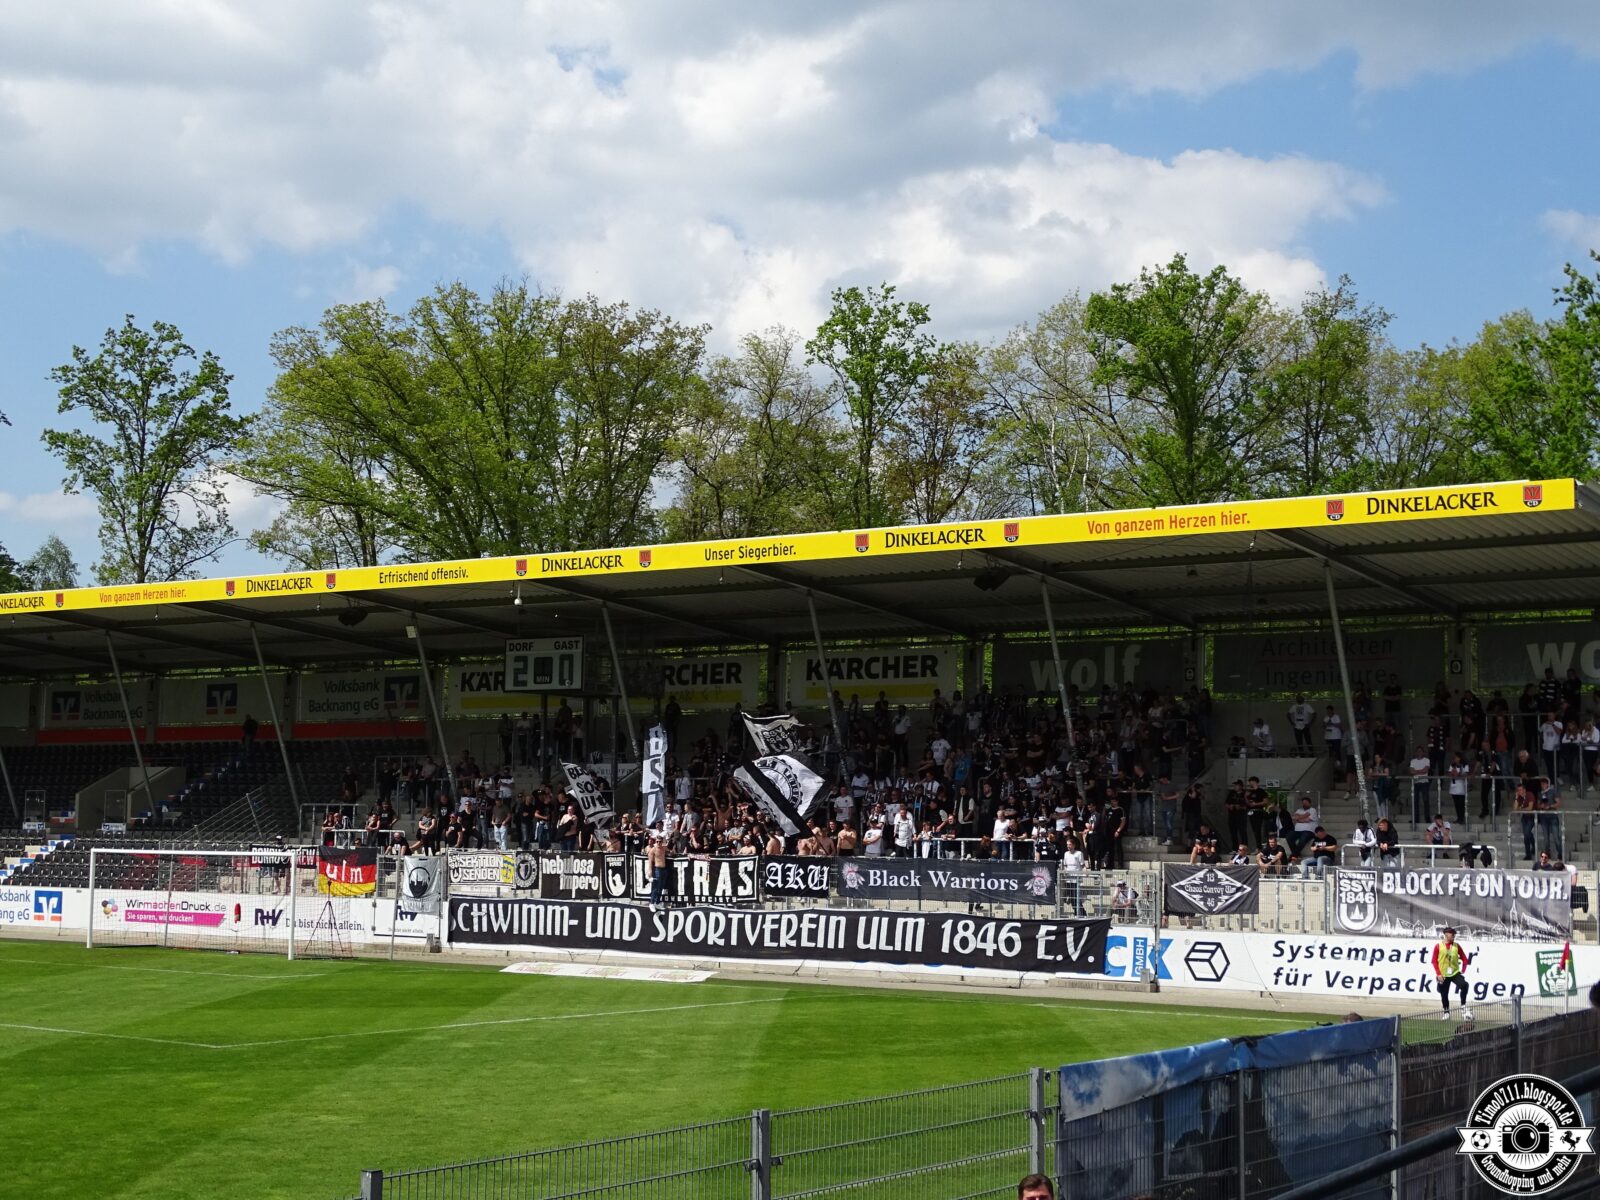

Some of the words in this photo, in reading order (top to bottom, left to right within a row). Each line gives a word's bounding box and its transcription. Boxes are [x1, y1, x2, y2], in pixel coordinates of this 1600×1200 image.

[1366, 491, 1498, 515] DINKELACKER
[1087, 520, 1110, 535] Von
[1115, 518, 1164, 537] ganzem
[1169, 514, 1216, 530] Herzen
[1221, 510, 1251, 526] hier.
[885, 528, 986, 549] DINKELACKER
[704, 547, 734, 561] Unser
[738, 543, 797, 561] Siegerbier.
[541, 554, 624, 573] DINKELACKER
[246, 577, 313, 593] DINKELACKER
[379, 570, 428, 584] Erfrischend
[431, 568, 469, 581] offensiv.
[99, 592, 112, 604] Von
[114, 591, 141, 605] ganzem
[142, 589, 169, 602] Herzen
[170, 587, 187, 600] hier.
[509, 641, 535, 652] DORF
[554, 640, 580, 651] GAST
[1262, 637, 1393, 658] Architekten
[806, 655, 939, 681] KÄRCHER
[1029, 644, 1142, 693] wolf
[324, 678, 380, 694] Volksbank
[535, 674, 551, 684] MIN
[308, 697, 361, 715] Backnang
[364, 697, 380, 711] eG
[325, 859, 363, 884] ulm
[462, 869, 501, 882] SENDEN
[542, 855, 594, 878] nebulosa
[559, 874, 599, 899] impero
[635, 858, 754, 897] UTRAS
[868, 869, 922, 887] Black
[927, 870, 1018, 894] Warriors
[1340, 879, 1375, 892] SSV
[1382, 871, 1444, 897] BLOCK
[1448, 873, 1471, 897] F4
[1475, 872, 1504, 898] ON
[1506, 874, 1568, 901] TOUR.
[125, 898, 227, 913] WirmachenDruck.de
[1340, 892, 1376, 904] 1846
[18, 909, 31, 921] eG
[127, 911, 136, 920] Sie
[254, 908, 285, 927] R+V
[300, 916, 314, 929] bist
[339, 919, 366, 932] allein.
[652, 911, 846, 949] SPORTVEREIN
[857, 916, 925, 953] ULM
[941, 919, 1022, 958] 1846
[1036, 924, 1095, 963] E.V.
[1134, 939, 1146, 975] GMBH
[1272, 940, 1479, 967] Systempartr
[1273, 966, 1313, 987] für
[1325, 969, 1526, 1001] Verpackgen
